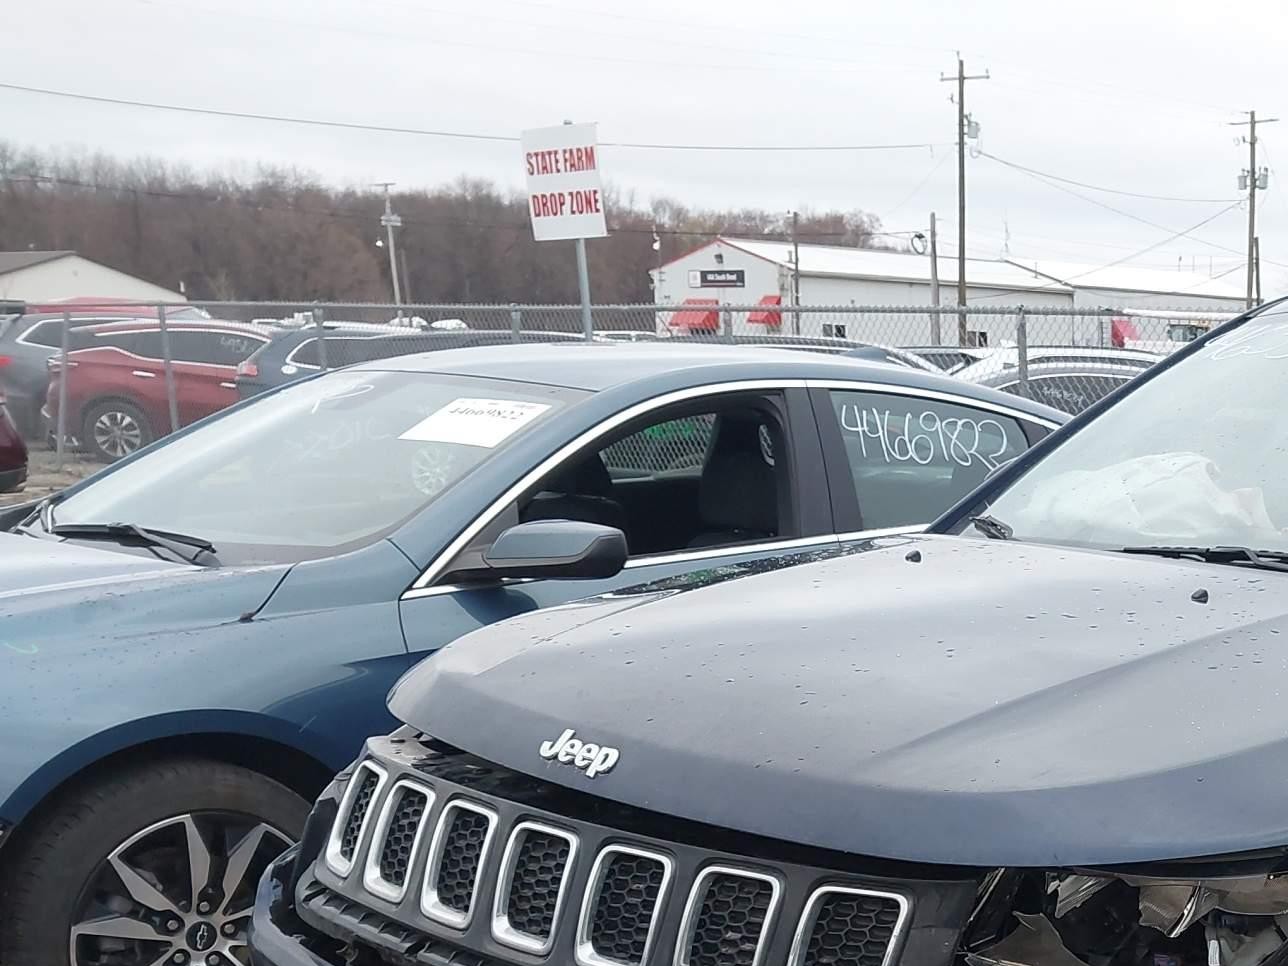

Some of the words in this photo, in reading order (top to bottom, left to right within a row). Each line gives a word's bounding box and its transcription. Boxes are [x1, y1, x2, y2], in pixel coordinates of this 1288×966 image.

[526, 148, 562, 177] STATE
[562, 145, 597, 174] FARM
[531, 192, 567, 218] DROP
[567, 189, 601, 215] ZONE
[540, 728, 620, 779] Jeep
